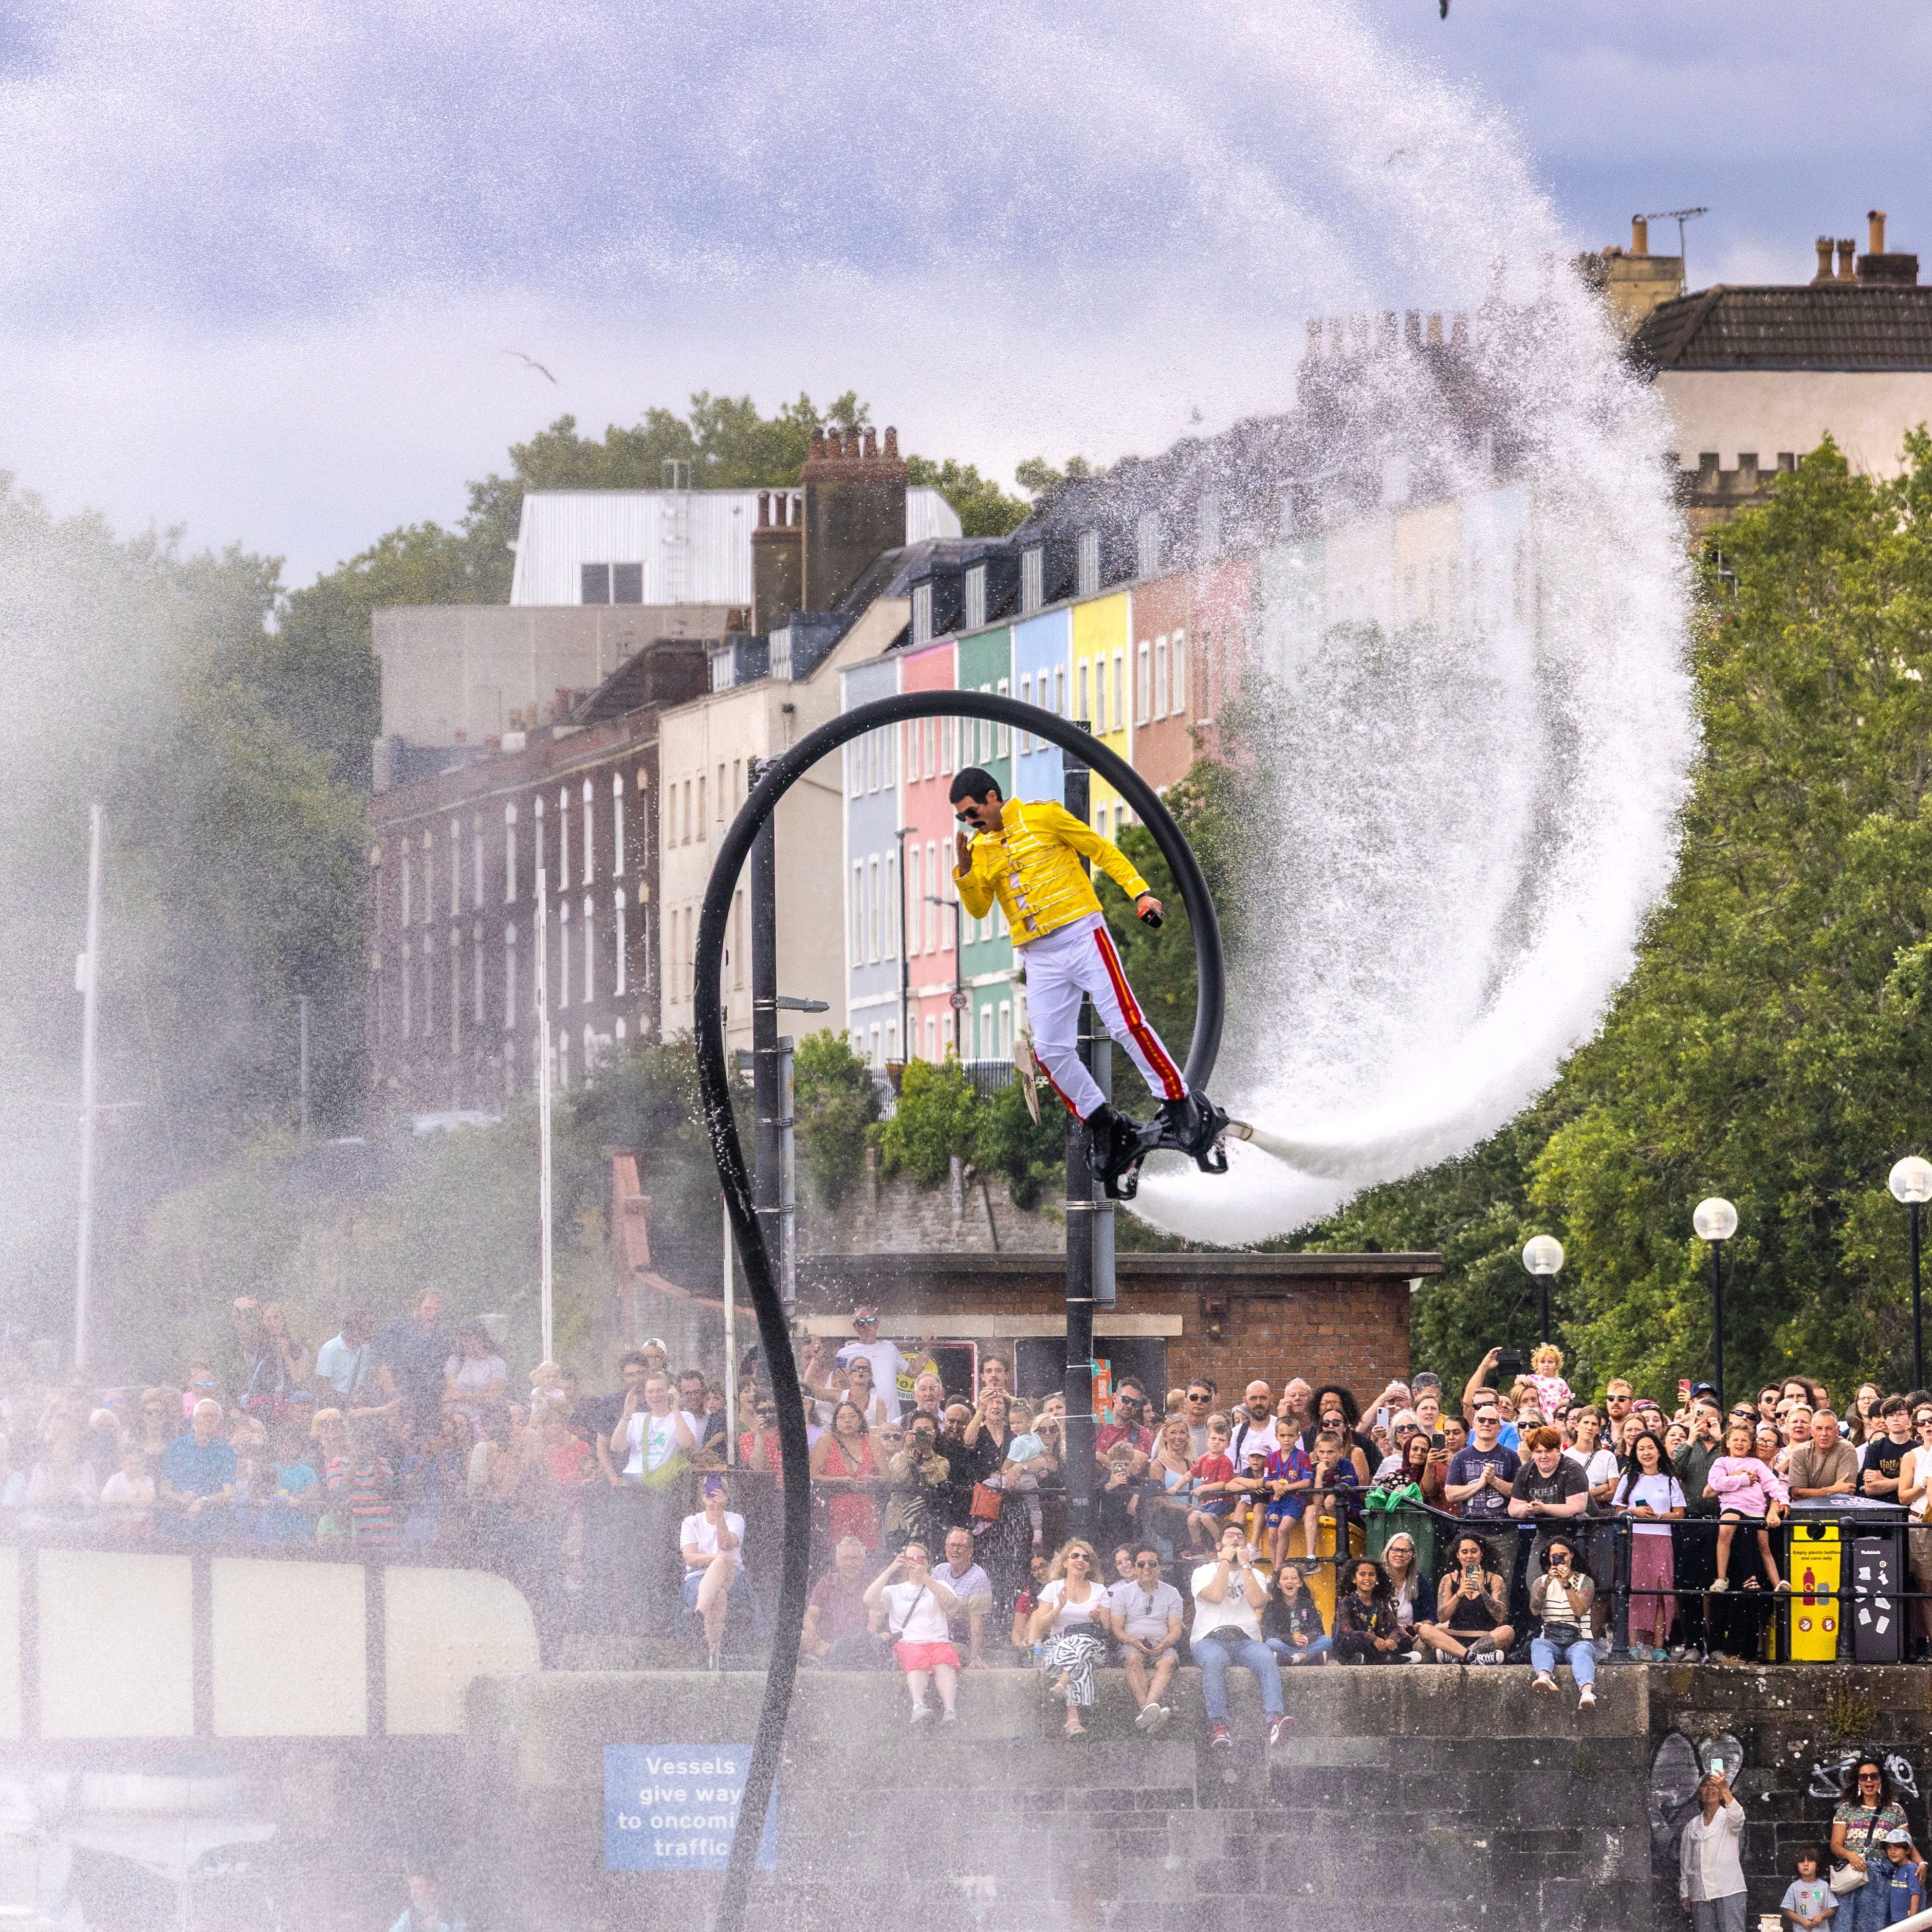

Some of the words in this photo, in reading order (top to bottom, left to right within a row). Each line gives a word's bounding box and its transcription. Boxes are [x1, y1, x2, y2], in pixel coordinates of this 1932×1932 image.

[646, 1757, 735, 1775] Vessels
[639, 1785, 687, 1805] give
[696, 1788, 741, 1805] way
[617, 1812, 641, 1829] to
[650, 1812, 736, 1829] oncomi
[654, 1838, 728, 1856] traffic
